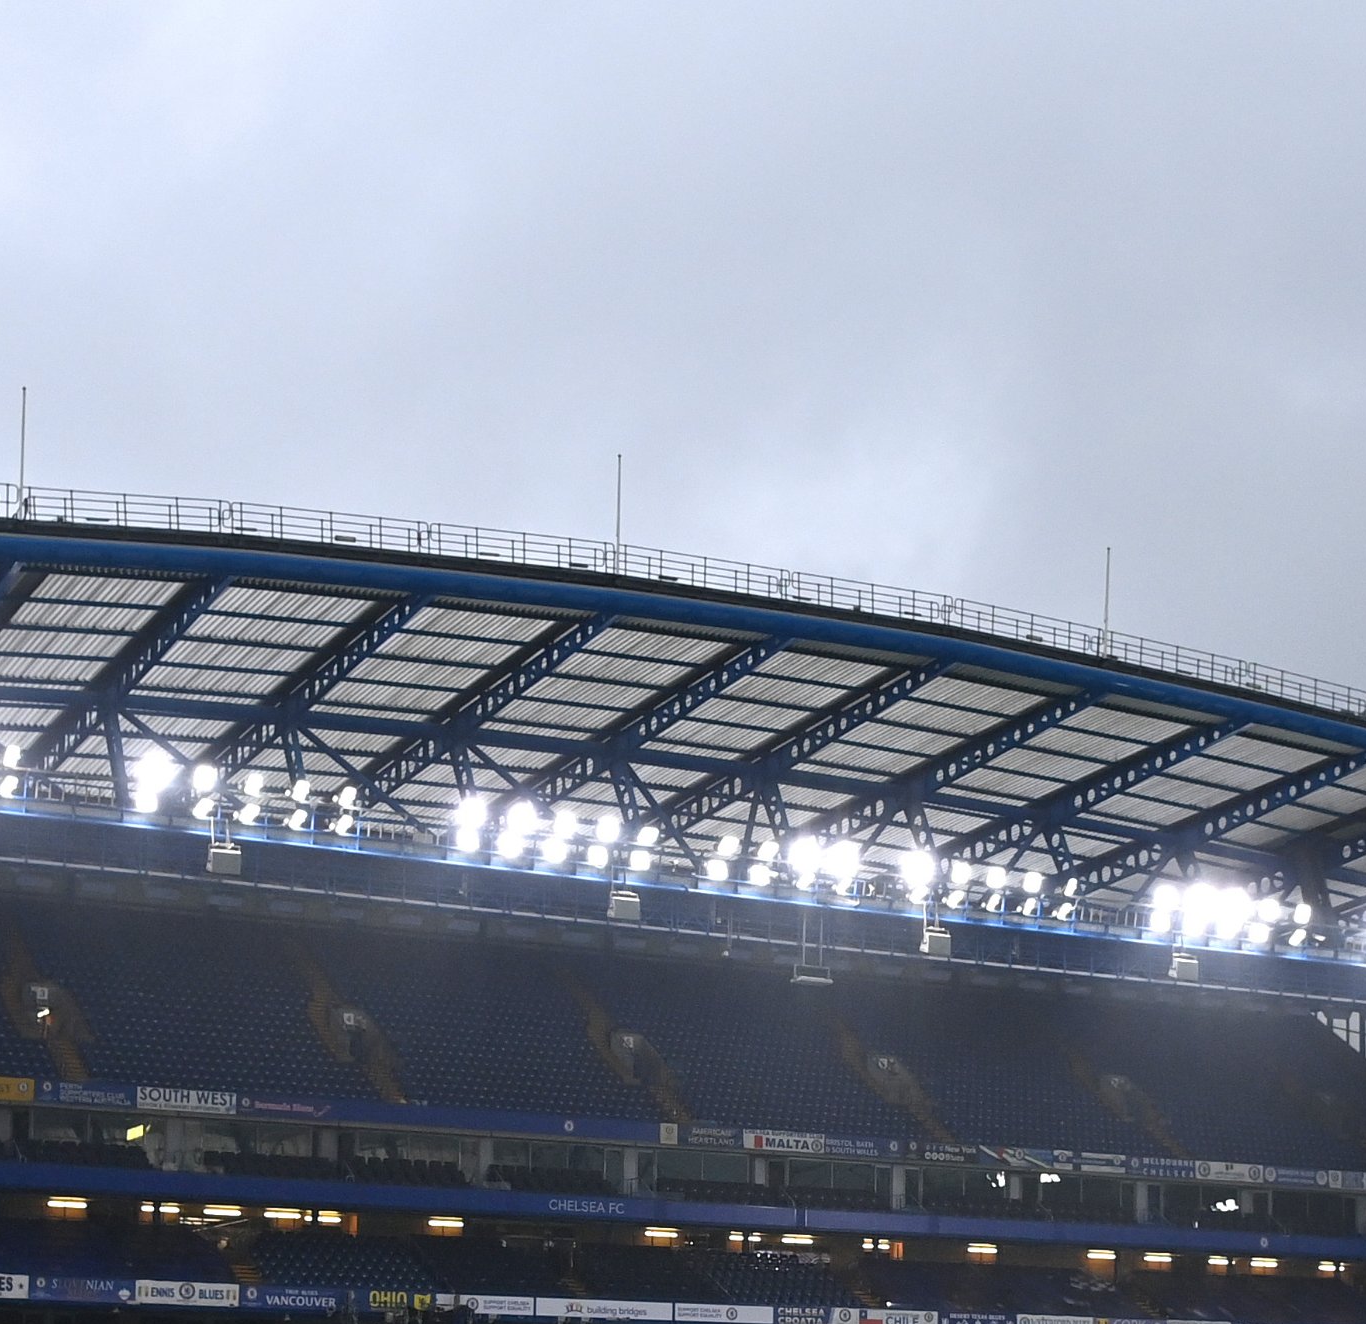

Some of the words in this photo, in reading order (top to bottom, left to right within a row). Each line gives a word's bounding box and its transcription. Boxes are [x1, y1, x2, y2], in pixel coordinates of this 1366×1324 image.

[139, 1087, 190, 1103] SOUTH
[196, 1091, 234, 1107] WEST
[688, 1136, 735, 1146] HEARTLAND
[765, 1137, 810, 1150] MALTA
[549, 1199, 605, 1213] CHELSEA
[608, 1202, 625, 1215] FC
[151, 1287, 175, 1299] ENNIS
[198, 1288, 224, 1301] BLUES
[369, 1290, 408, 1309] OHIO
[266, 1295, 336, 1309] VANCOUVER
[587, 1305, 618, 1317] building
[619, 1306, 647, 1318] bridges
[778, 1307, 825, 1317] CHELSEA
